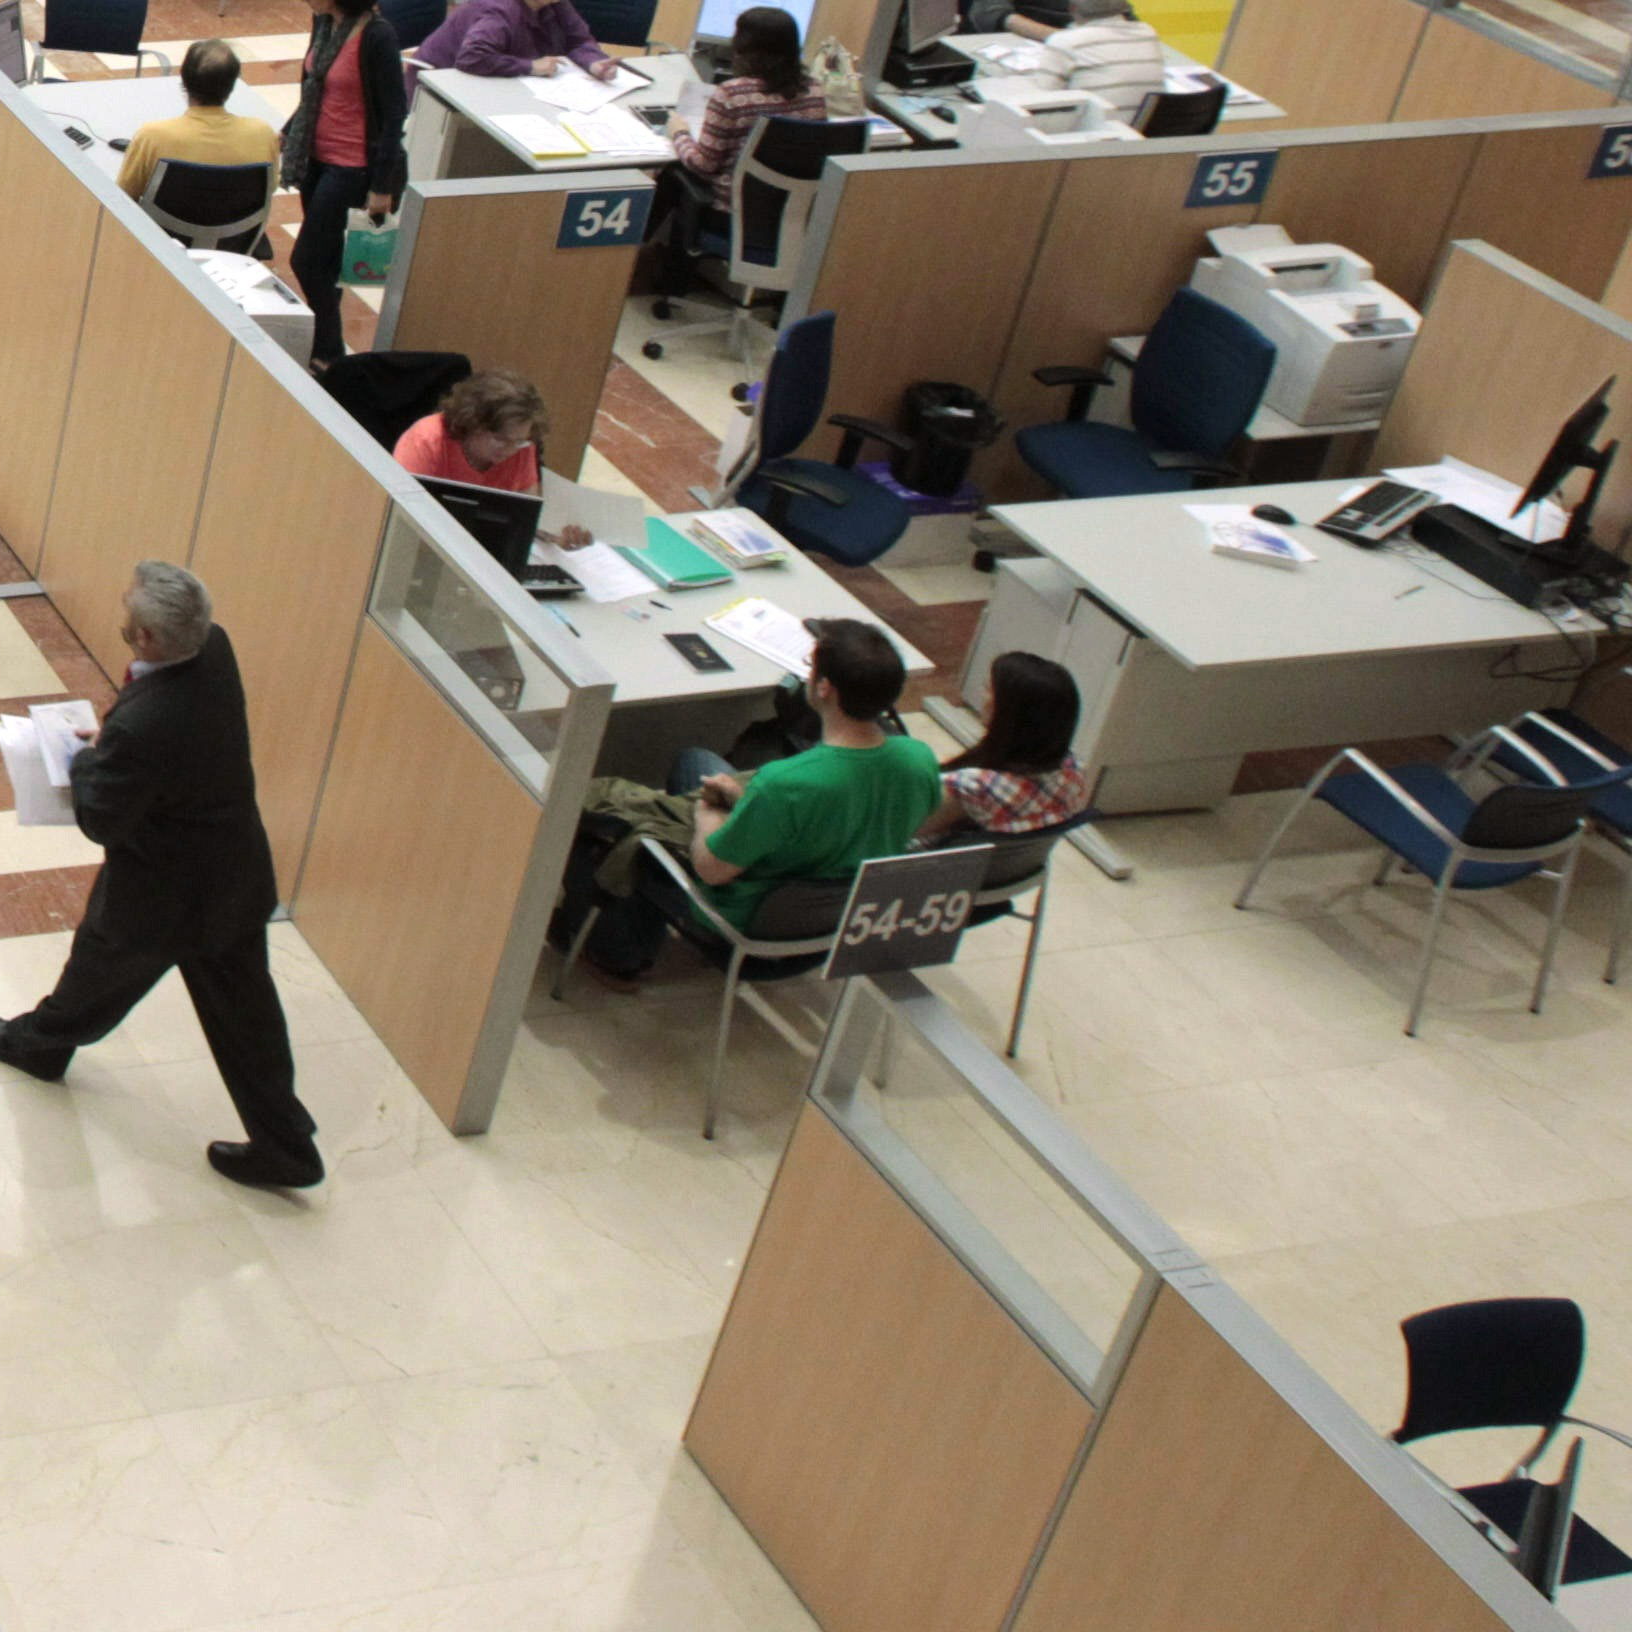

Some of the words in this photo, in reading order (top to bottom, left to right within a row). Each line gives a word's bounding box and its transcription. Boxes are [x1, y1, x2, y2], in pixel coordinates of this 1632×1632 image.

[1201, 159, 1260, 199] 55
[575, 196, 632, 239] 54
[842, 887, 972, 947] 54-59
